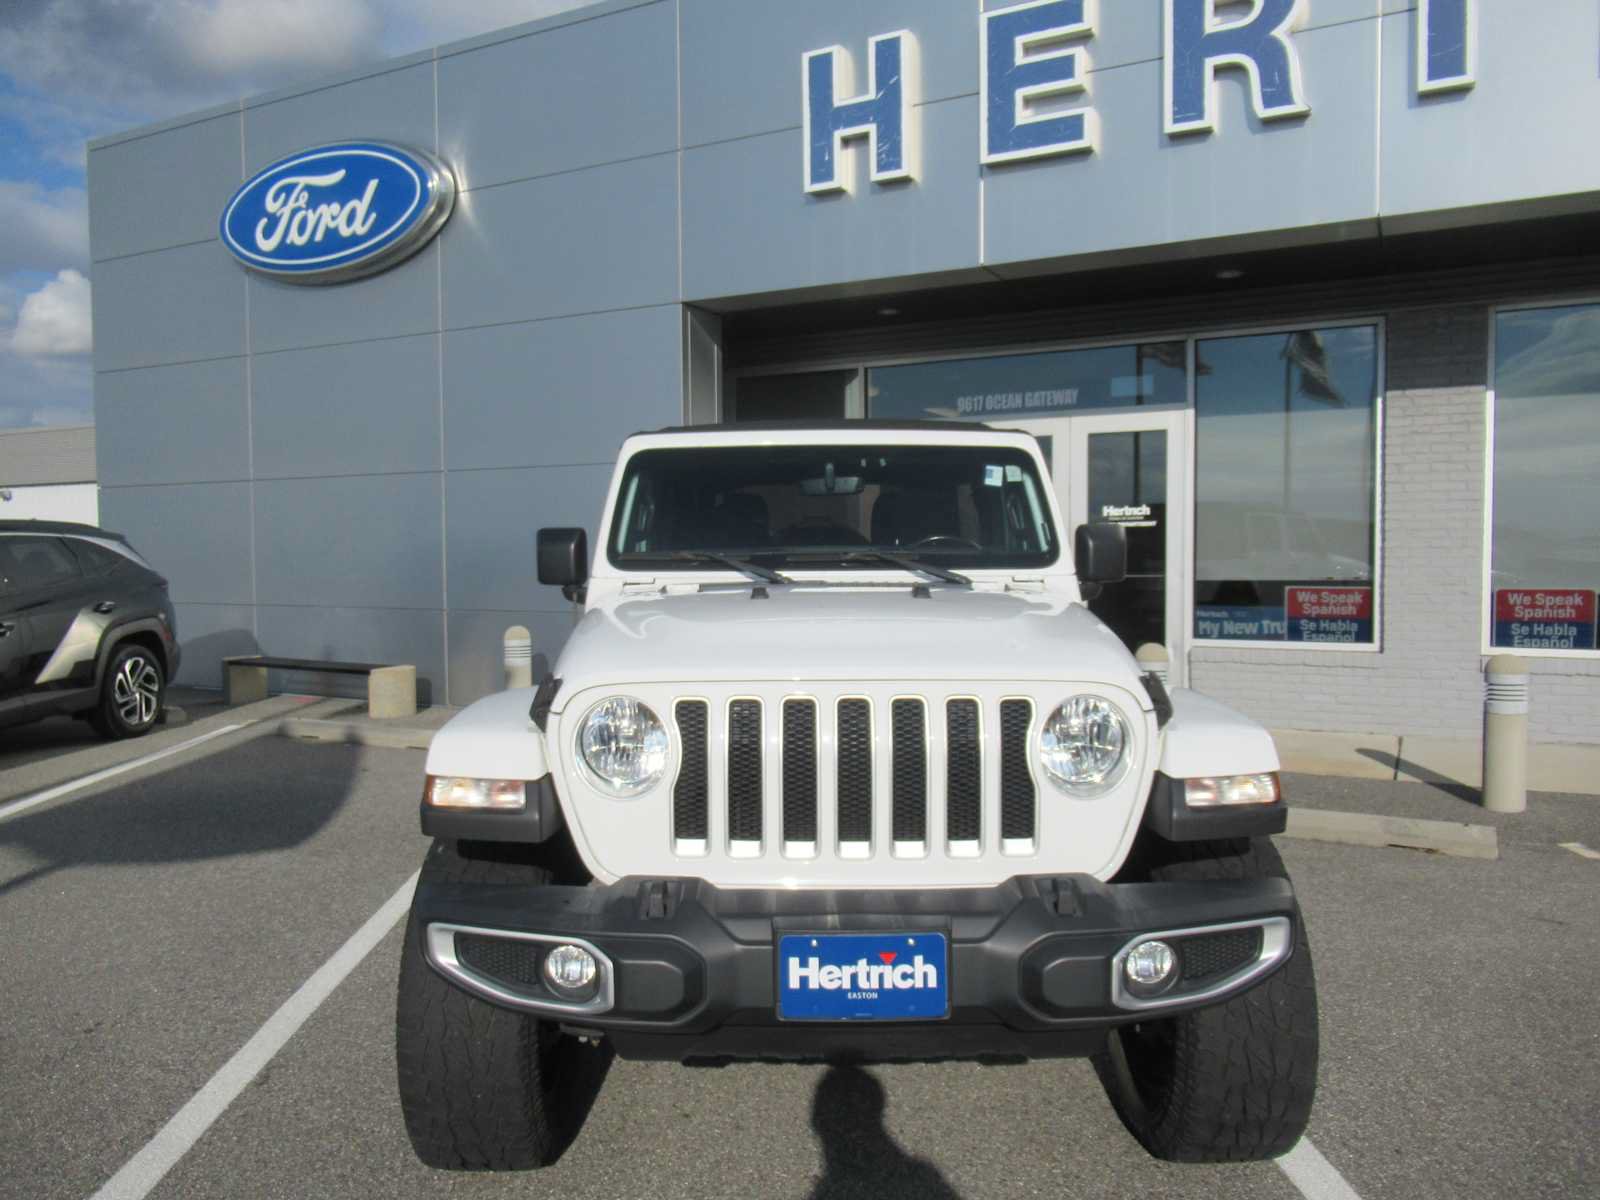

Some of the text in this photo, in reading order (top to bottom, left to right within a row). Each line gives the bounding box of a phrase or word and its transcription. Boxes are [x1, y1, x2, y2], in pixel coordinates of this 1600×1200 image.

[255, 169, 379, 251] Ford
[957, 388, 1079, 413] 9617 OCEAN GATEWAY
[1296, 591, 1363, 606] We Speak
[1508, 592, 1584, 608] We Speak
[1303, 603, 1357, 618] Spanish
[1514, 605, 1577, 621] Spanish
[1223, 620, 1258, 635] New
[1300, 619, 1359, 632] Se Habla
[1511, 623, 1577, 636] Se Habla
[1303, 631, 1356, 642] Español
[1513, 635, 1574, 648] Español
[788, 952, 937, 989] Hertrich
[847, 992, 879, 1000] EASTON
